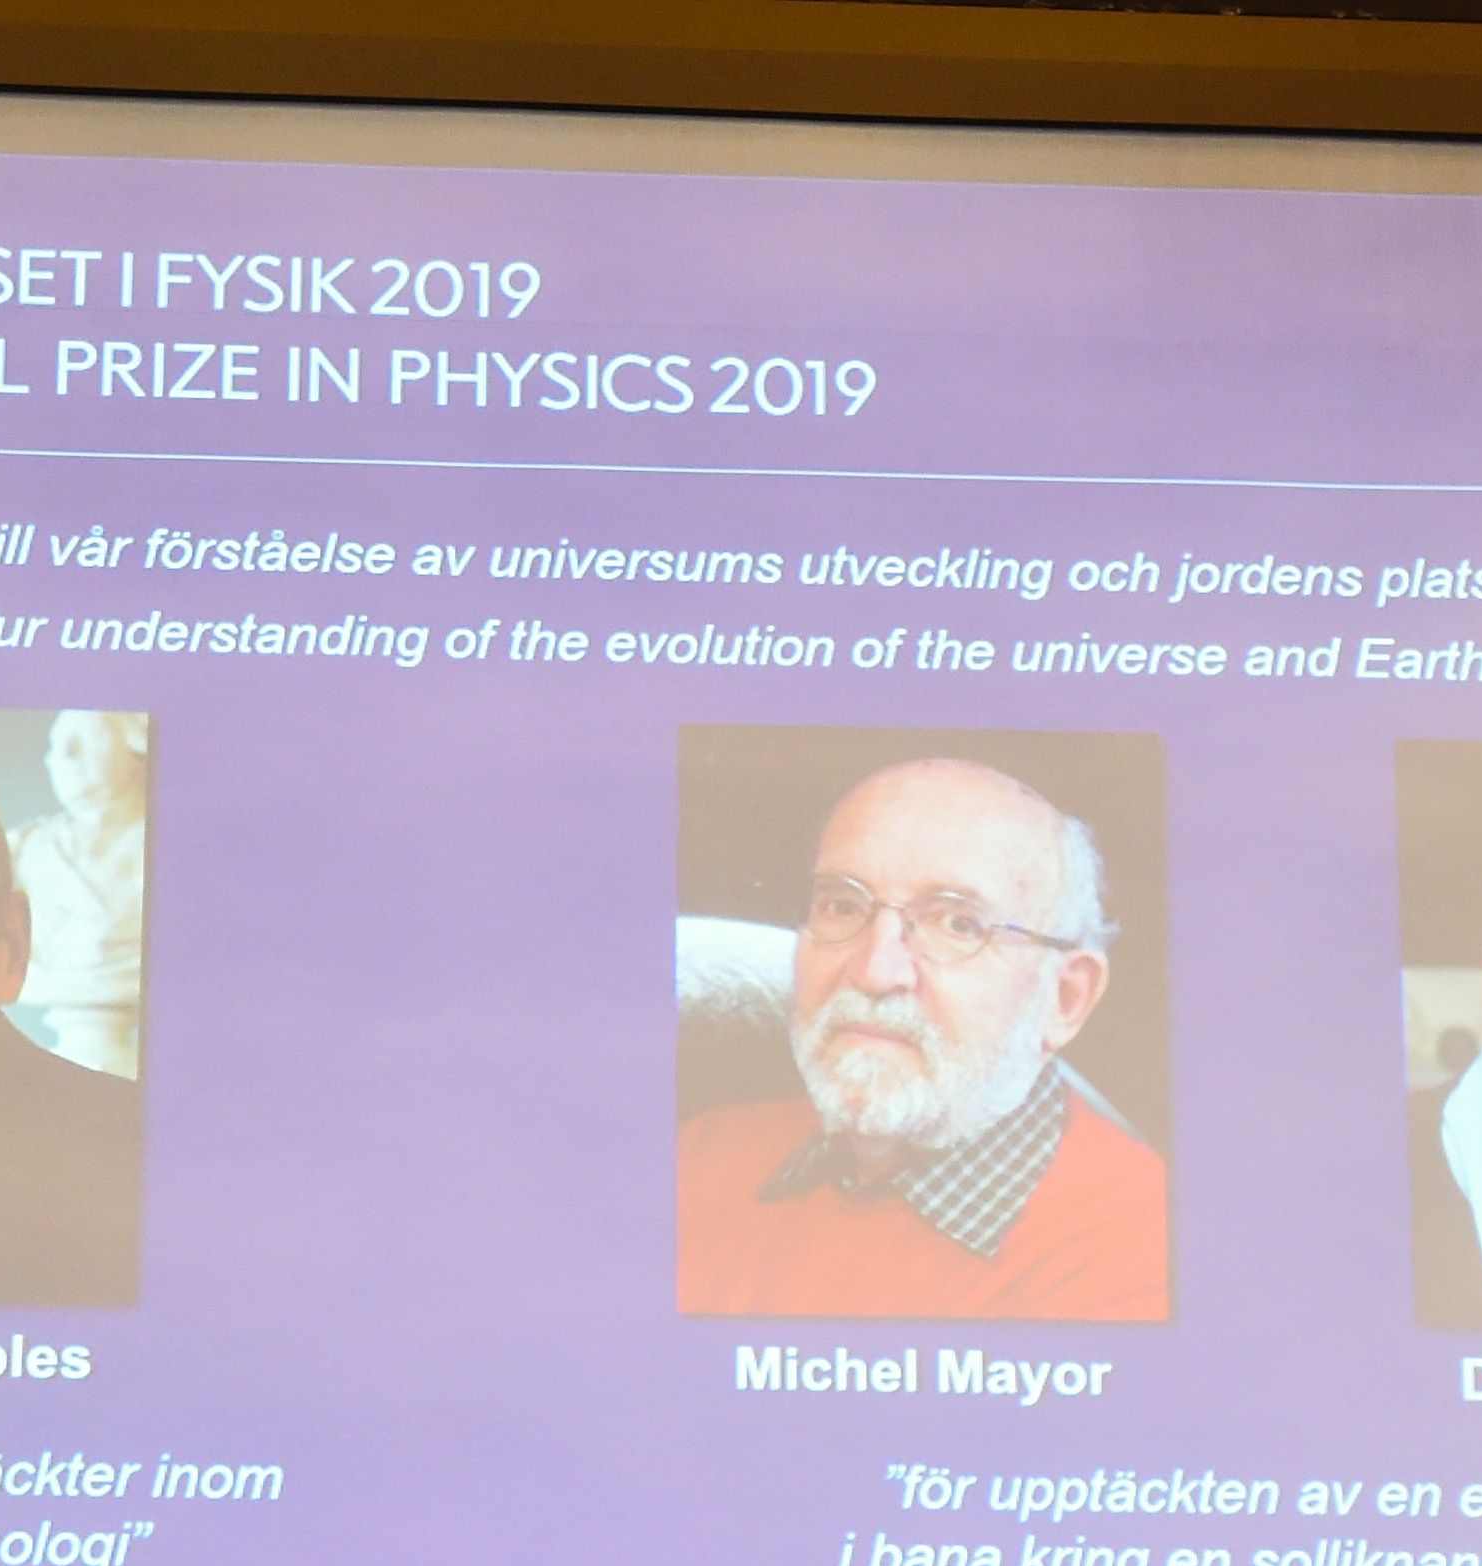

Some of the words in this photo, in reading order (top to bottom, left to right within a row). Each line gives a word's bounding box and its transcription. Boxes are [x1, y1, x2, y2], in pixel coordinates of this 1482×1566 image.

[120, 250, 135, 308] I
[156, 251, 357, 315] FYSIK
[369, 257, 541, 319] 2019
[56, 339, 260, 401] PRIZE
[287, 345, 361, 404] IN
[390, 348, 695, 414] PHYSICS
[709, 355, 877, 417] 2019
[49, 524, 135, 568] vår
[143, 527, 396, 575] förståelse
[410, 543, 477, 577] av
[488, 537, 784, 584] universums
[798, 545, 1054, 601] utveckling
[1067, 551, 1161, 593] och
[1167, 552, 1364, 604] jordens
[59, 609, 430, 668] understanding
[444, 618, 502, 660] of
[508, 619, 590, 662] the
[605, 623, 836, 668] evolution
[851, 627, 908, 669] of
[915, 628, 996, 672] the
[1011, 631, 1228, 676] universe
[1243, 636, 1342, 678] and
[735, 1345, 918, 1393] Michel
[937, 1348, 1113, 1407] Mayor
[150, 1452, 284, 1501] inom
[988, 1467, 1280, 1523] upptäckten
[1296, 1480, 1363, 1516] av
[1376, 1481, 1442, 1517] en
